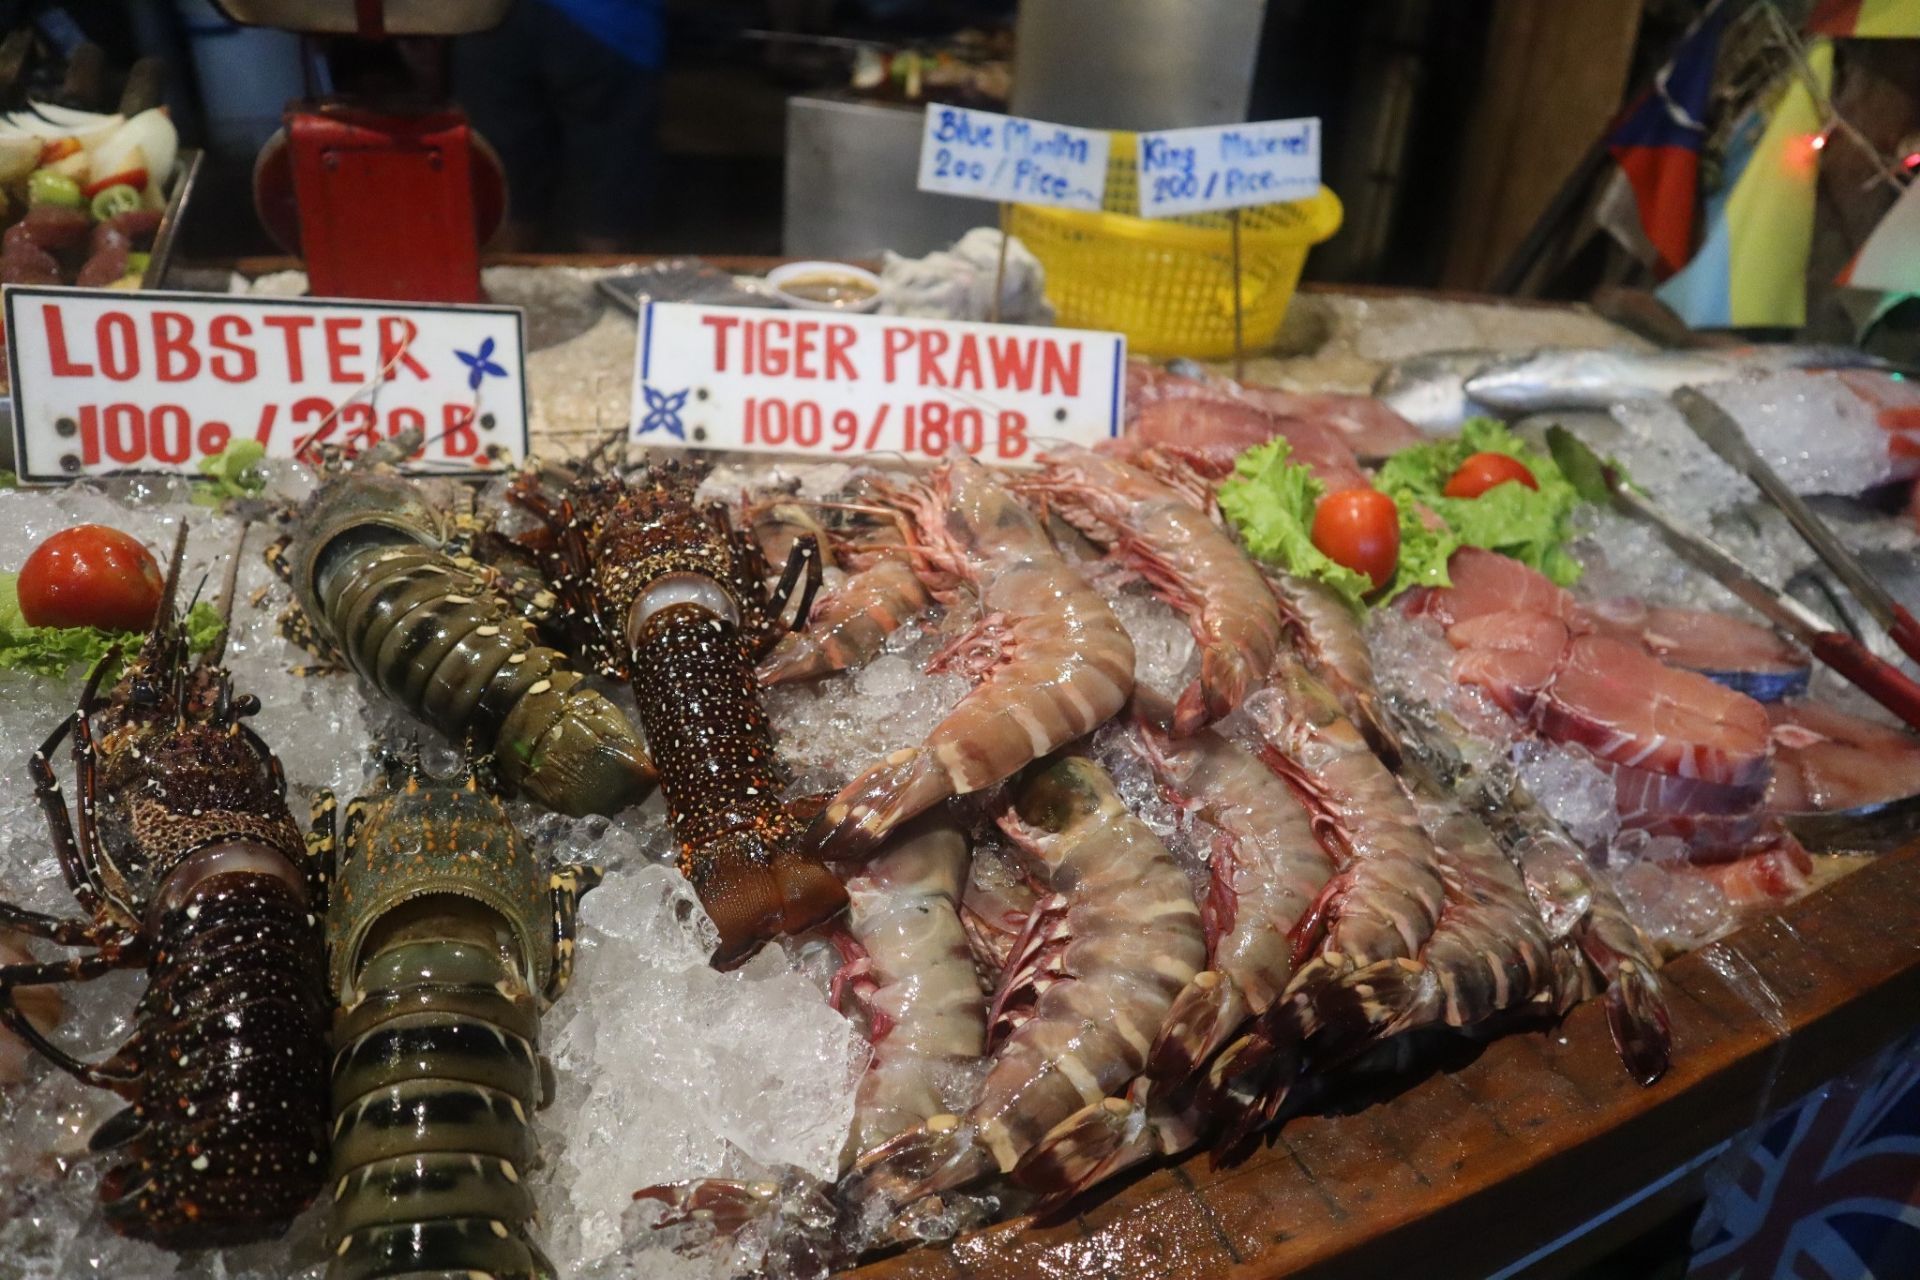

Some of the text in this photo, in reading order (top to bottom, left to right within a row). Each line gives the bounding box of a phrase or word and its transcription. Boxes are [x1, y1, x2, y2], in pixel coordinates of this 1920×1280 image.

[934, 109, 993, 149] Blue
[1142, 136, 1196, 173] King
[42, 304, 431, 384] LOBSTER
[702, 315, 1081, 397] TIGER PRAWN
